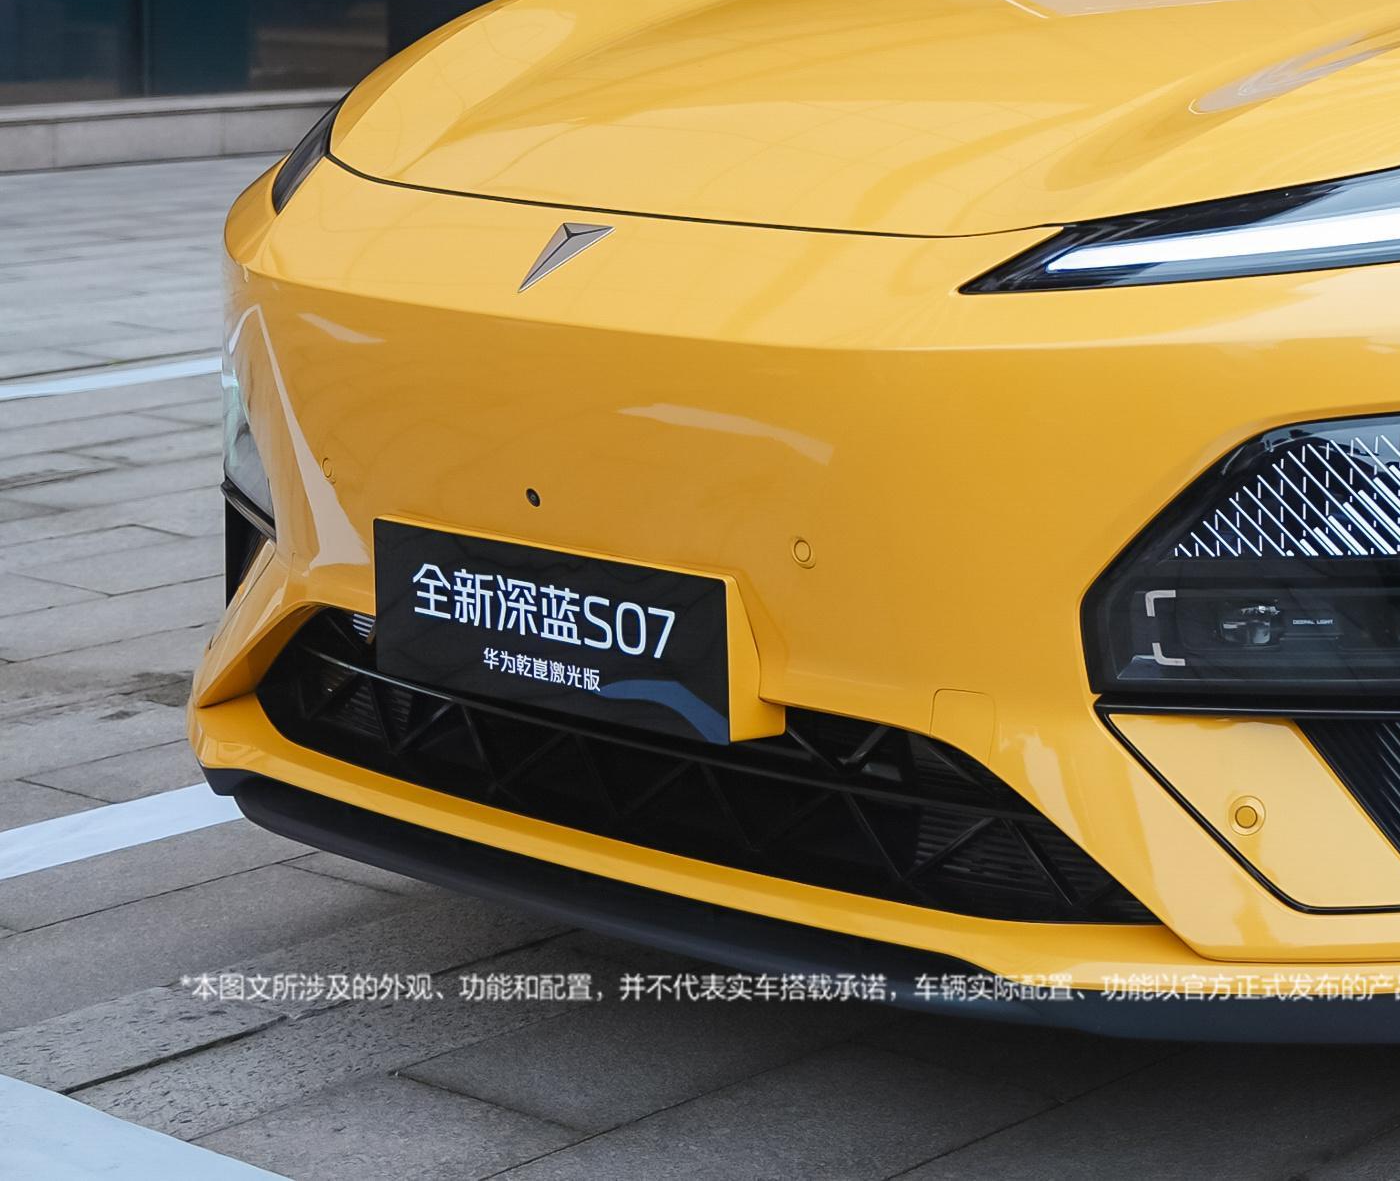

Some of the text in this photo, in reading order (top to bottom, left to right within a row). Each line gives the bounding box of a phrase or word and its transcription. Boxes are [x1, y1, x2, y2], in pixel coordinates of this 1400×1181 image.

[412, 563, 676, 659] 全新深蓝S07
[483, 647, 600, 692] 华为乾崑激光版
